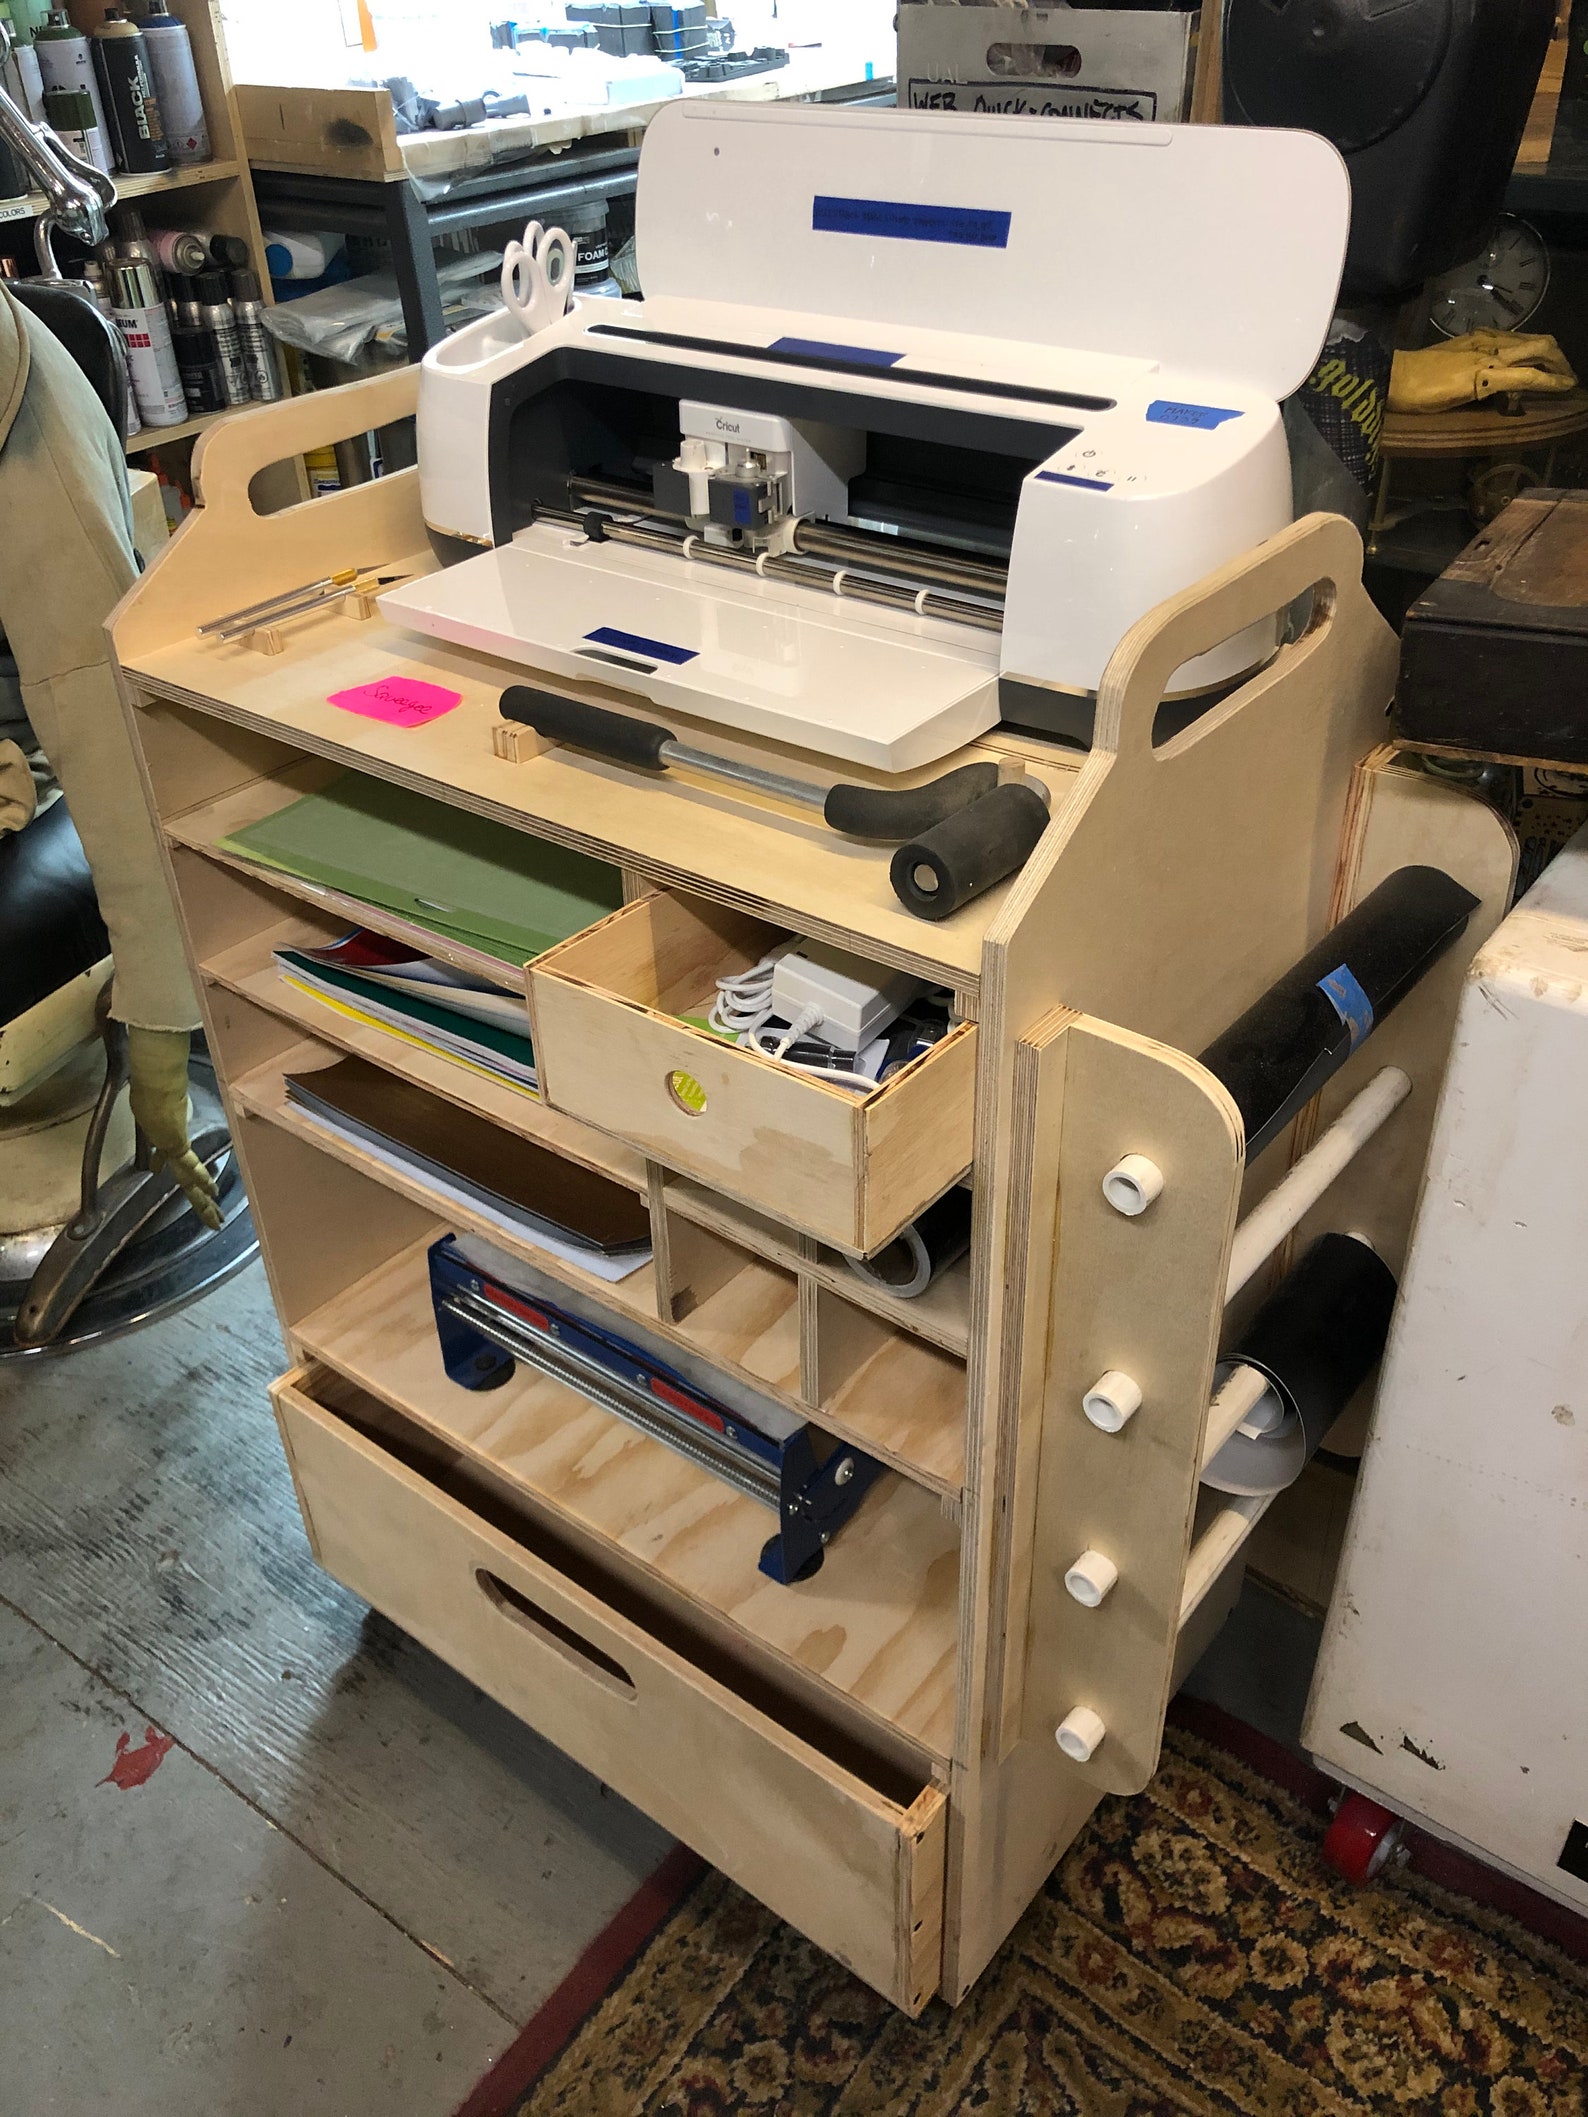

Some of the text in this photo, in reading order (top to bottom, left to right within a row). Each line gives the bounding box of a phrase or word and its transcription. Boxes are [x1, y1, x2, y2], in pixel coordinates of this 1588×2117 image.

[127, 76, 151, 139] BLACK
[914, 92, 957, 110] WEB
[715, 418, 740, 433] Cricut
